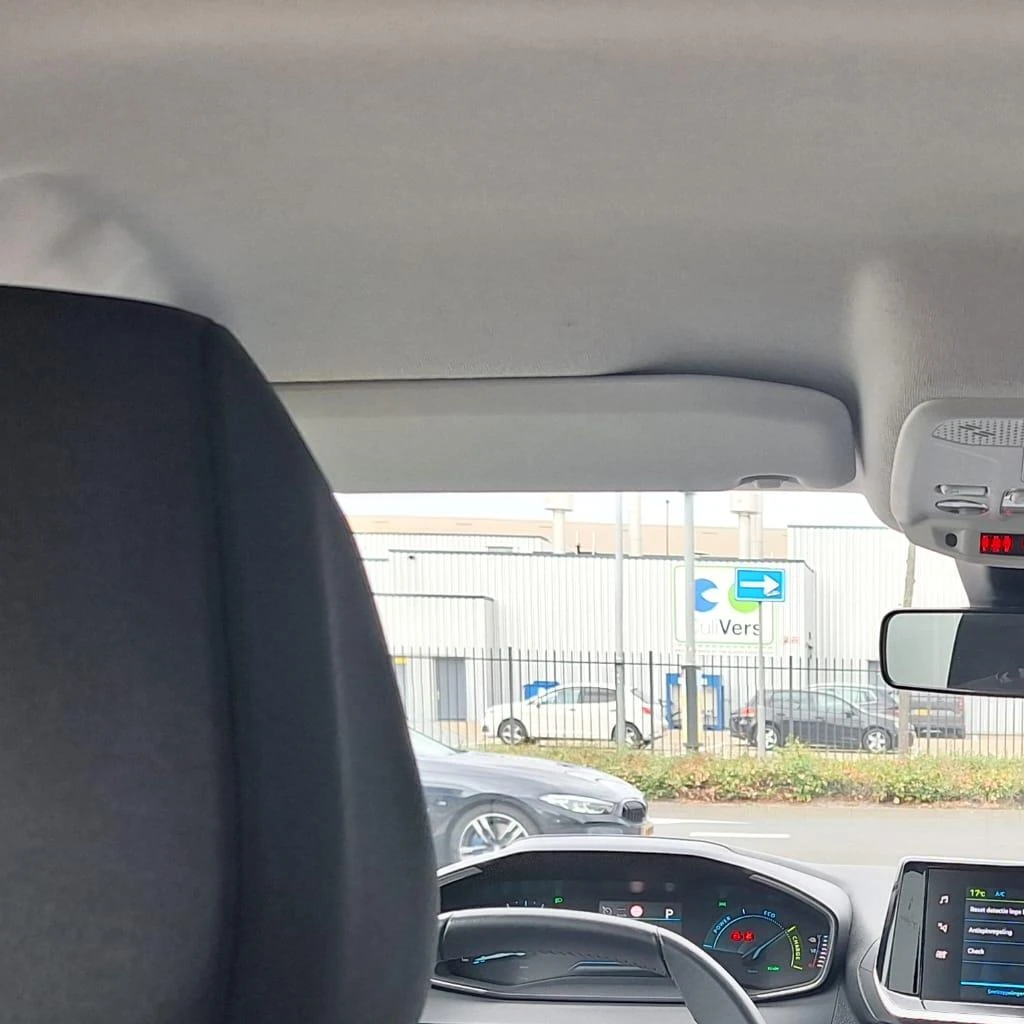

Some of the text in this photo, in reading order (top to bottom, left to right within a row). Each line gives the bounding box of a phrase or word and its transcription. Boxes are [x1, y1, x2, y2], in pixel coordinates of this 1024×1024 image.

[665, 908, 674, 920] P
[763, 909, 777, 919] ECO
[712, 915, 732, 934] POWER
[791, 935, 801, 961] CHARGE
